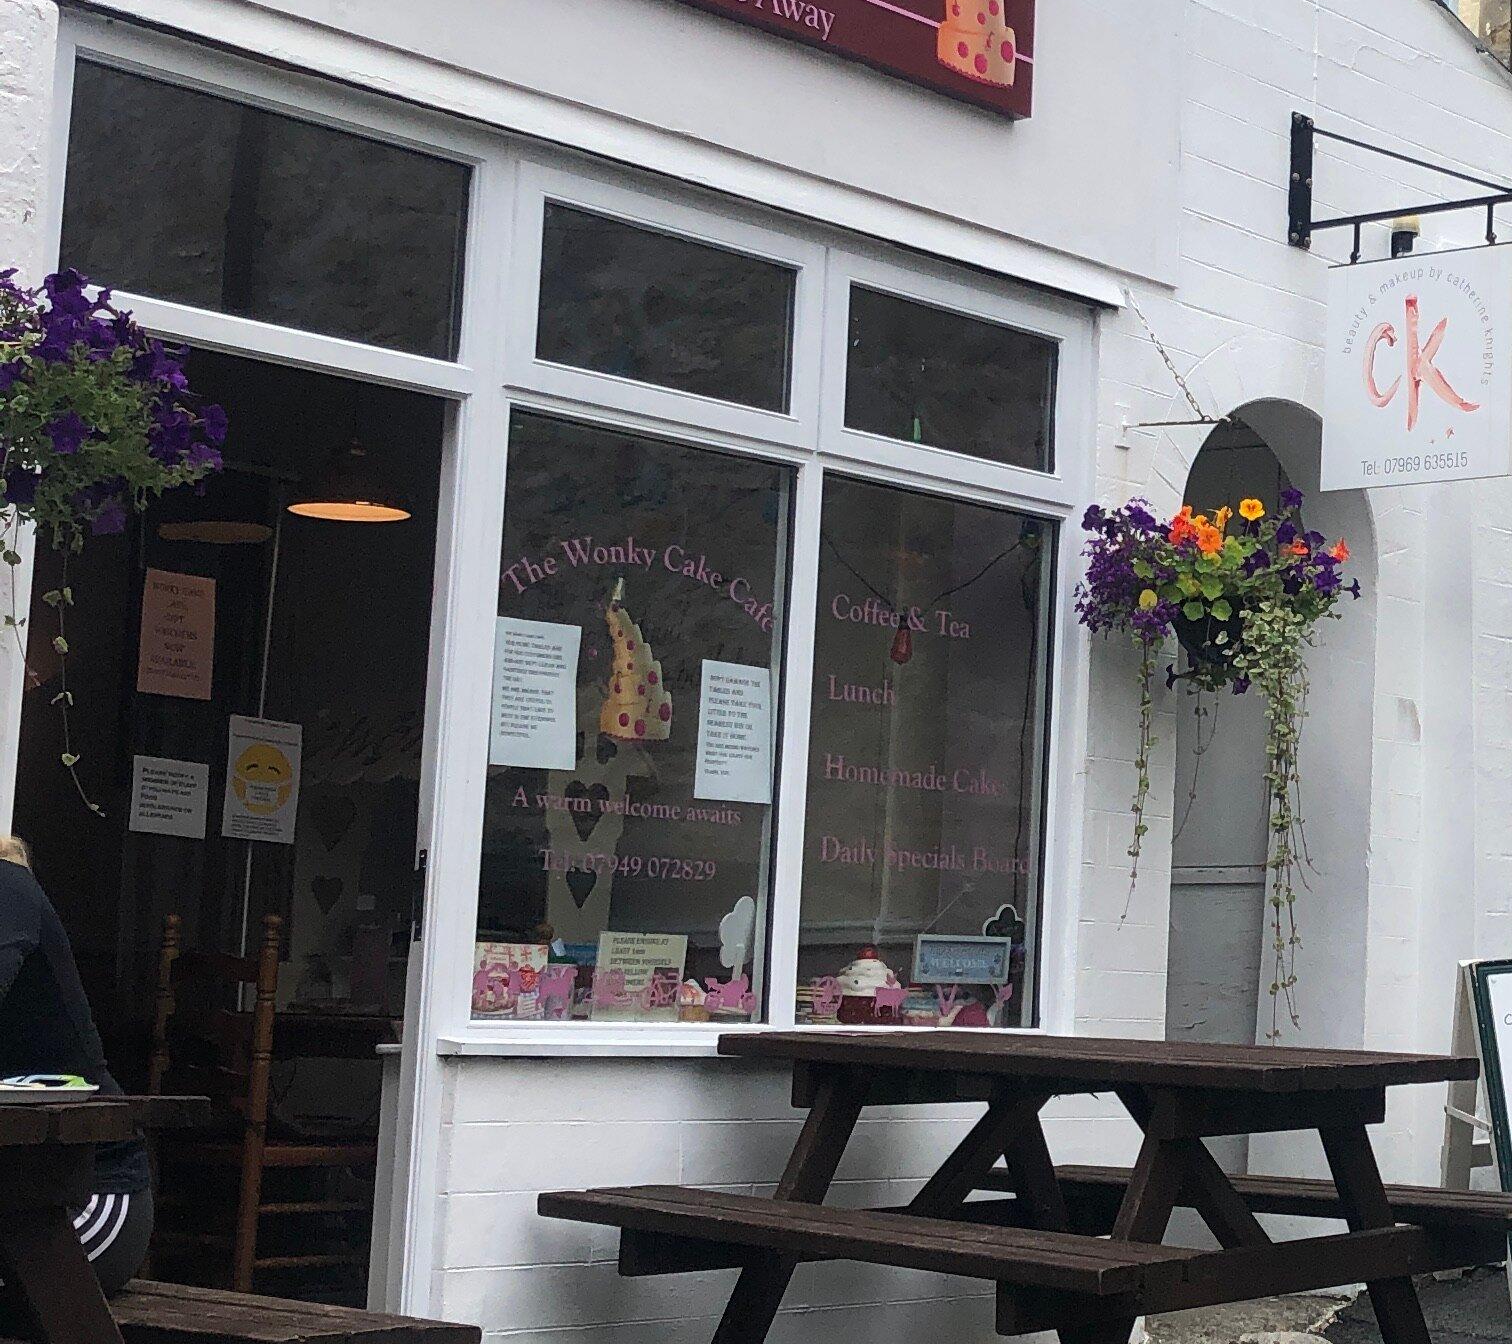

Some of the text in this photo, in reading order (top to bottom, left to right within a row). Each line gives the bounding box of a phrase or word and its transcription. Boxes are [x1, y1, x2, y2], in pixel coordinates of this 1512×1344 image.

[1342, 266, 1494, 386] beauty & makeup by catherine knights
[1384, 455, 1421, 474] 07969
[1423, 451, 1468, 471] 635515
[500, 555, 559, 594] The
[560, 536, 657, 571] Wonky
[664, 544, 723, 590] Cake
[831, 593, 971, 639] Coffee & Tea
[827, 674, 897, 706] Lunch
[824, 753, 947, 791] Homemade
[511, 785, 743, 826] A warm welcome awaits
[647, 856, 717, 881] 072829
[820, 835, 877, 869] Daily
